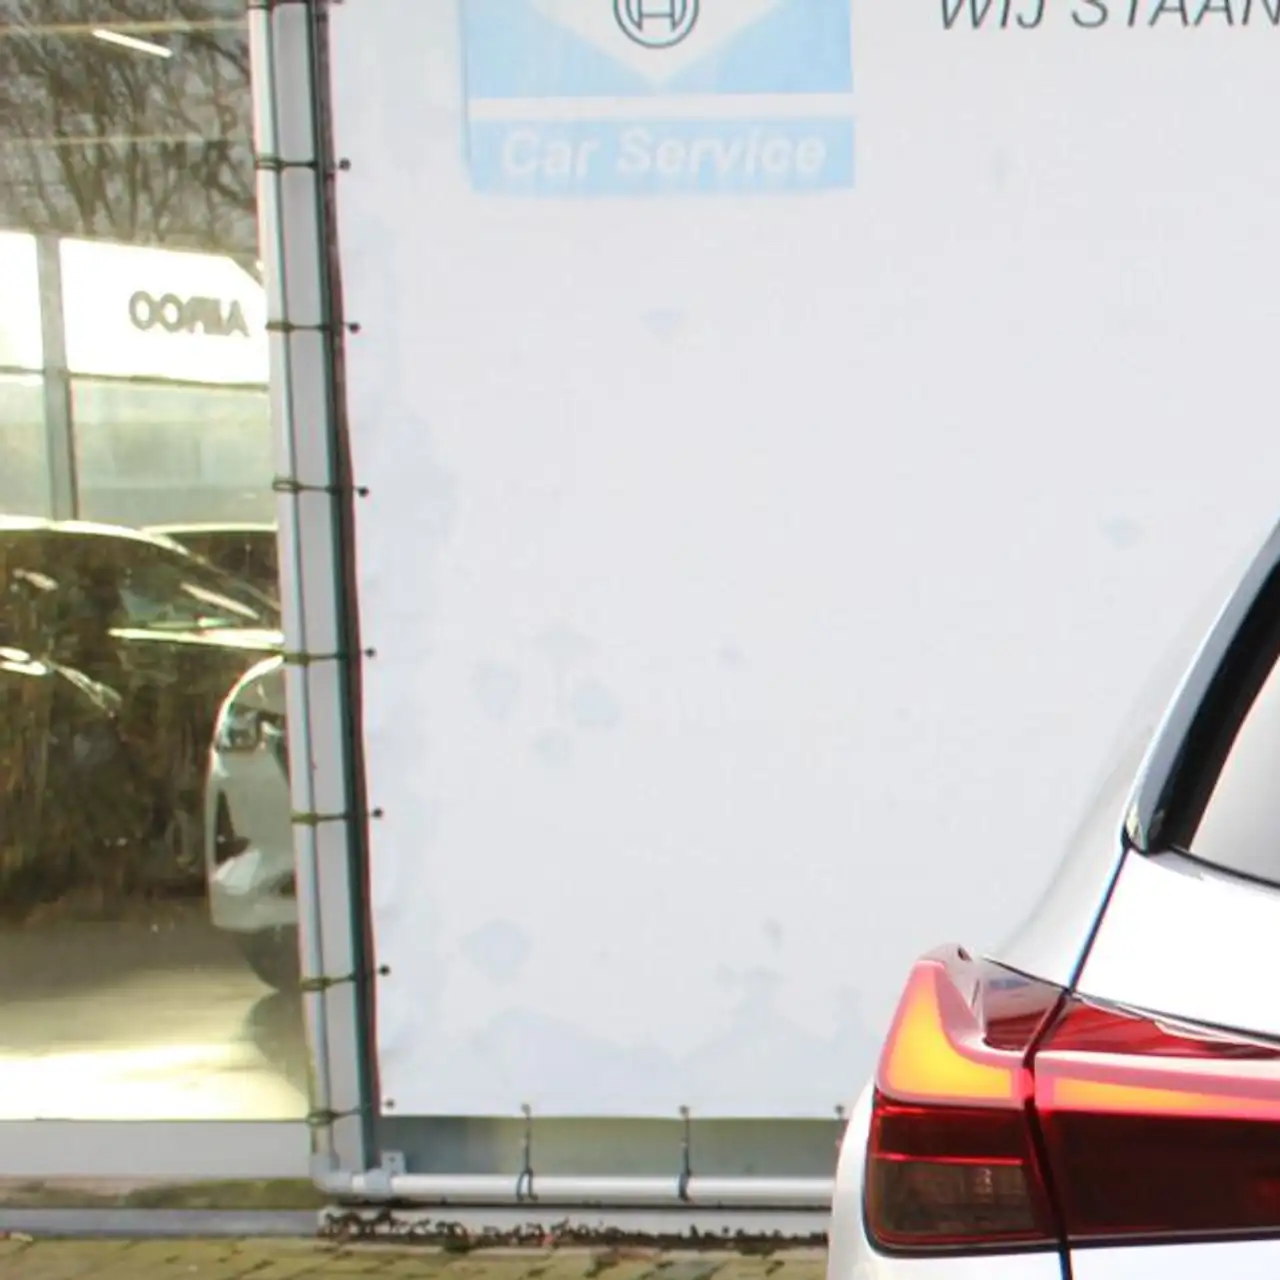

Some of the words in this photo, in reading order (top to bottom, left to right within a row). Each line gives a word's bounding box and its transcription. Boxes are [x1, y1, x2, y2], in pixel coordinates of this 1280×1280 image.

[940, 0, 1046, 29] WIJ
[502, 126, 598, 177] Car
[616, 125, 827, 176] Service
